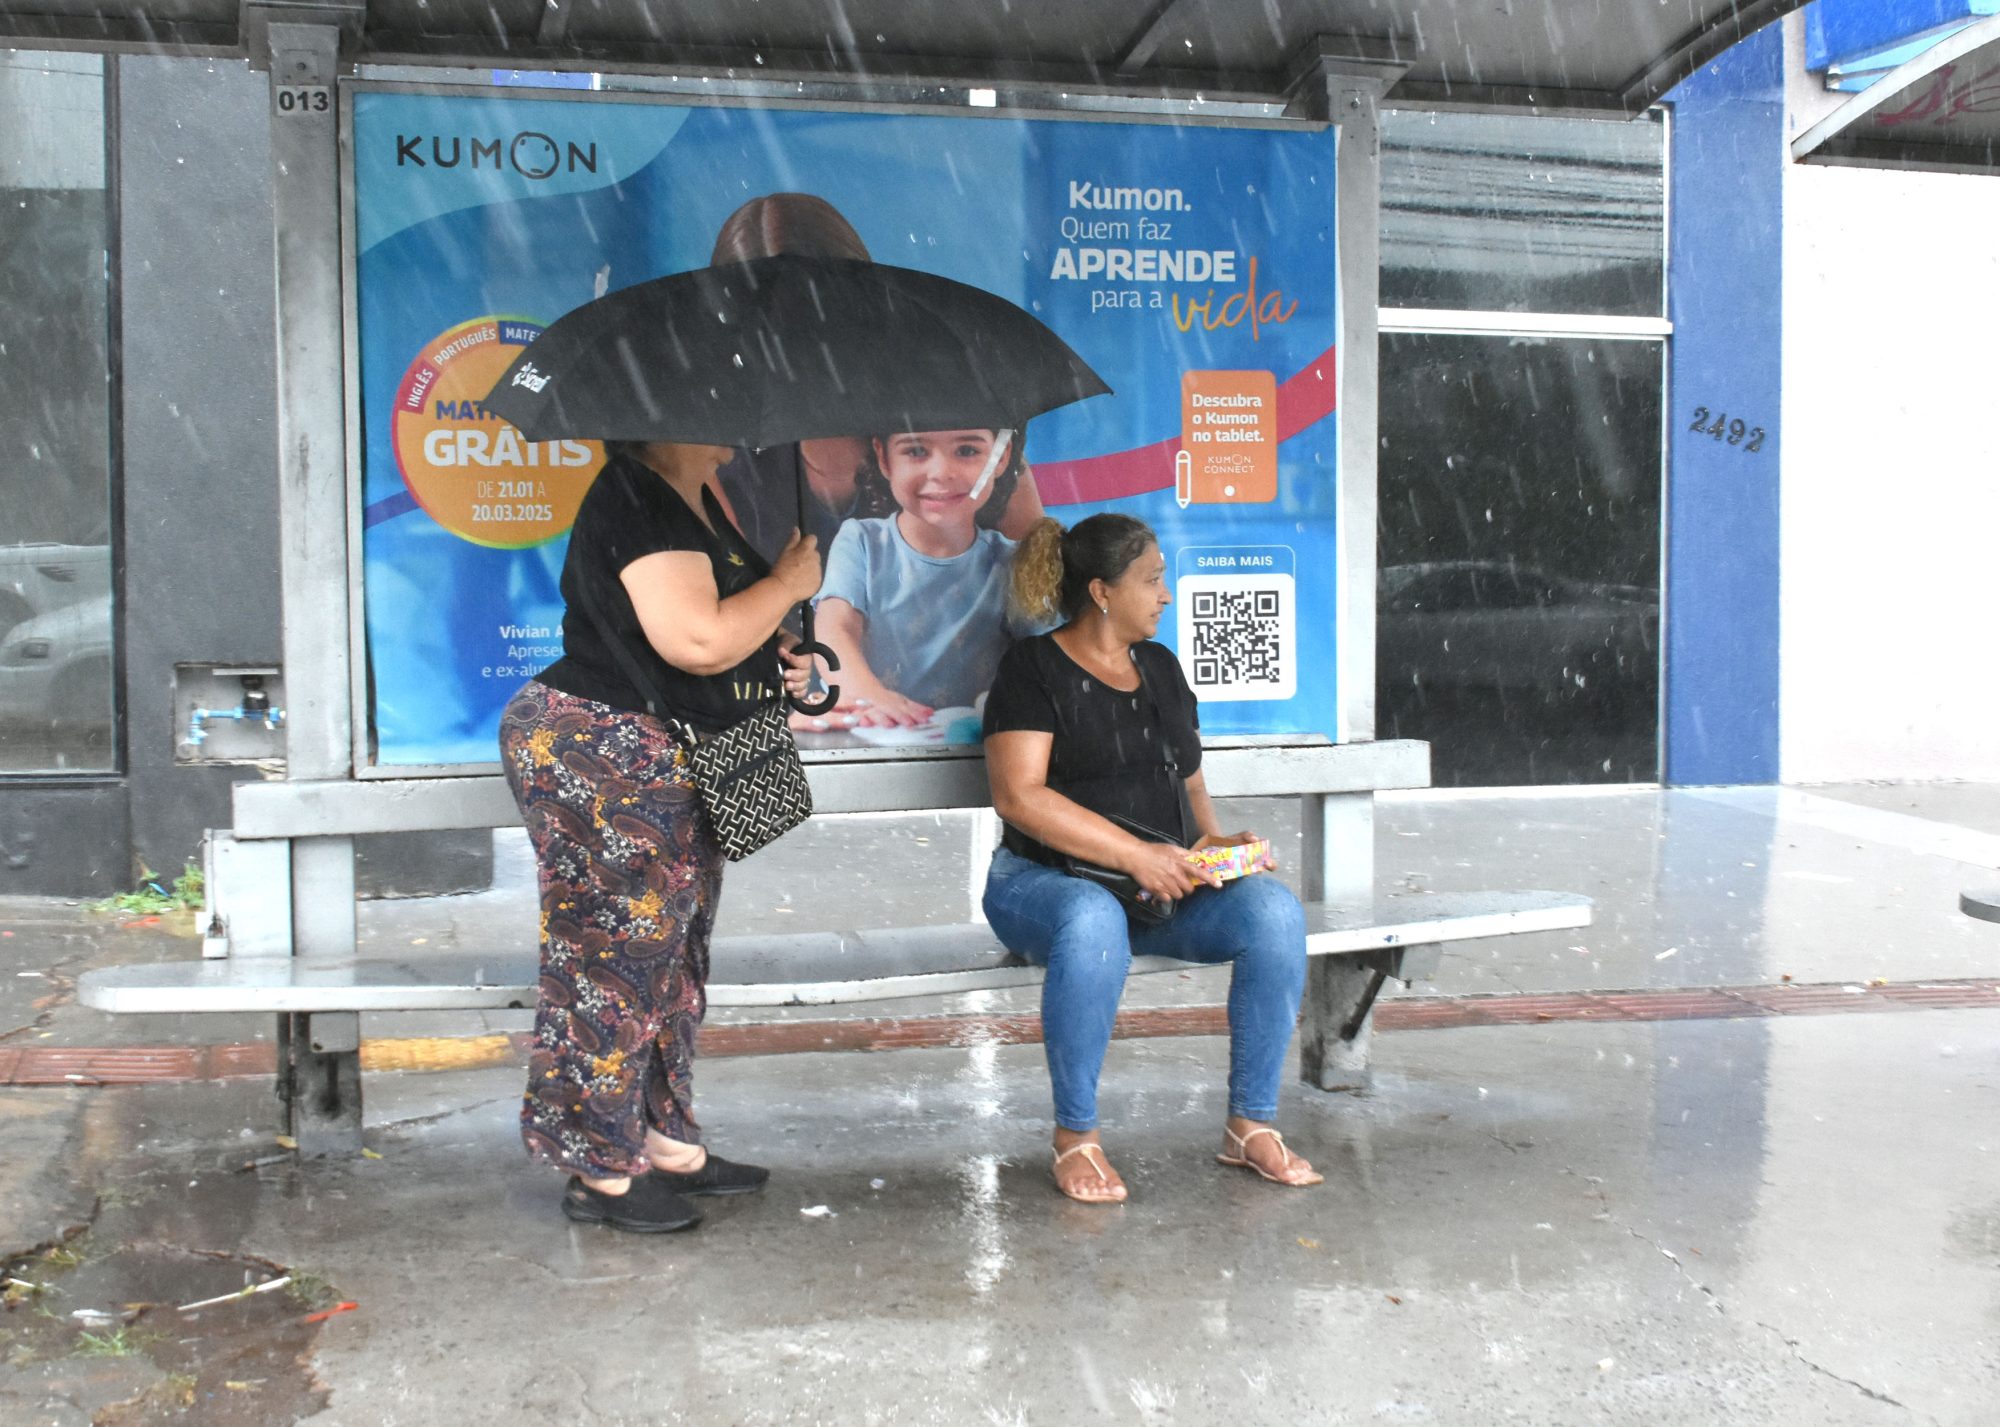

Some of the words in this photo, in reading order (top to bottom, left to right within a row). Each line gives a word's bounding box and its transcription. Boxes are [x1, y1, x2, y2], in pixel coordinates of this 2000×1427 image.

[278, 90, 329, 112] 013
[396, 131, 597, 180] KUMON
[1069, 181, 1192, 212] Kumon.
[1060, 216, 1130, 244] Quem
[1137, 217, 1173, 240] faz
[1050, 248, 1236, 282] APRENDE
[1091, 290, 1142, 313] para
[1149, 291, 1163, 308] a
[1172, 256, 1298, 342] vida
[505, 327, 540, 342] MATE
[433, 327, 497, 366] PORTUGUÊS
[407, 368, 434, 408] INGLÊS
[1192, 393, 1262, 407] Descubra
[1192, 414, 1202, 424] o
[1205, 412, 1258, 424] Kumon
[1192, 431, 1211, 442] no
[1215, 428, 1264, 442] tablet.
[1688, 406, 1765, 453] 2492
[423, 425, 592, 467] GRÁTIS
[1207, 454, 1251, 465] KUMON
[1204, 465, 1255, 474] CONNECT
[477, 481, 494, 498] DE
[497, 481, 533, 498] 21.01
[537, 481, 546, 497] A
[472, 504, 553, 521] 20.03.2025
[1197, 556, 1236, 567] SAIBA
[1240, 555, 1273, 566] MAIS
[499, 624, 550, 639] Vivian
[507, 645, 565, 660] Aprese
[482, 666, 492, 677] e
[496, 663, 549, 677] ex-alu
